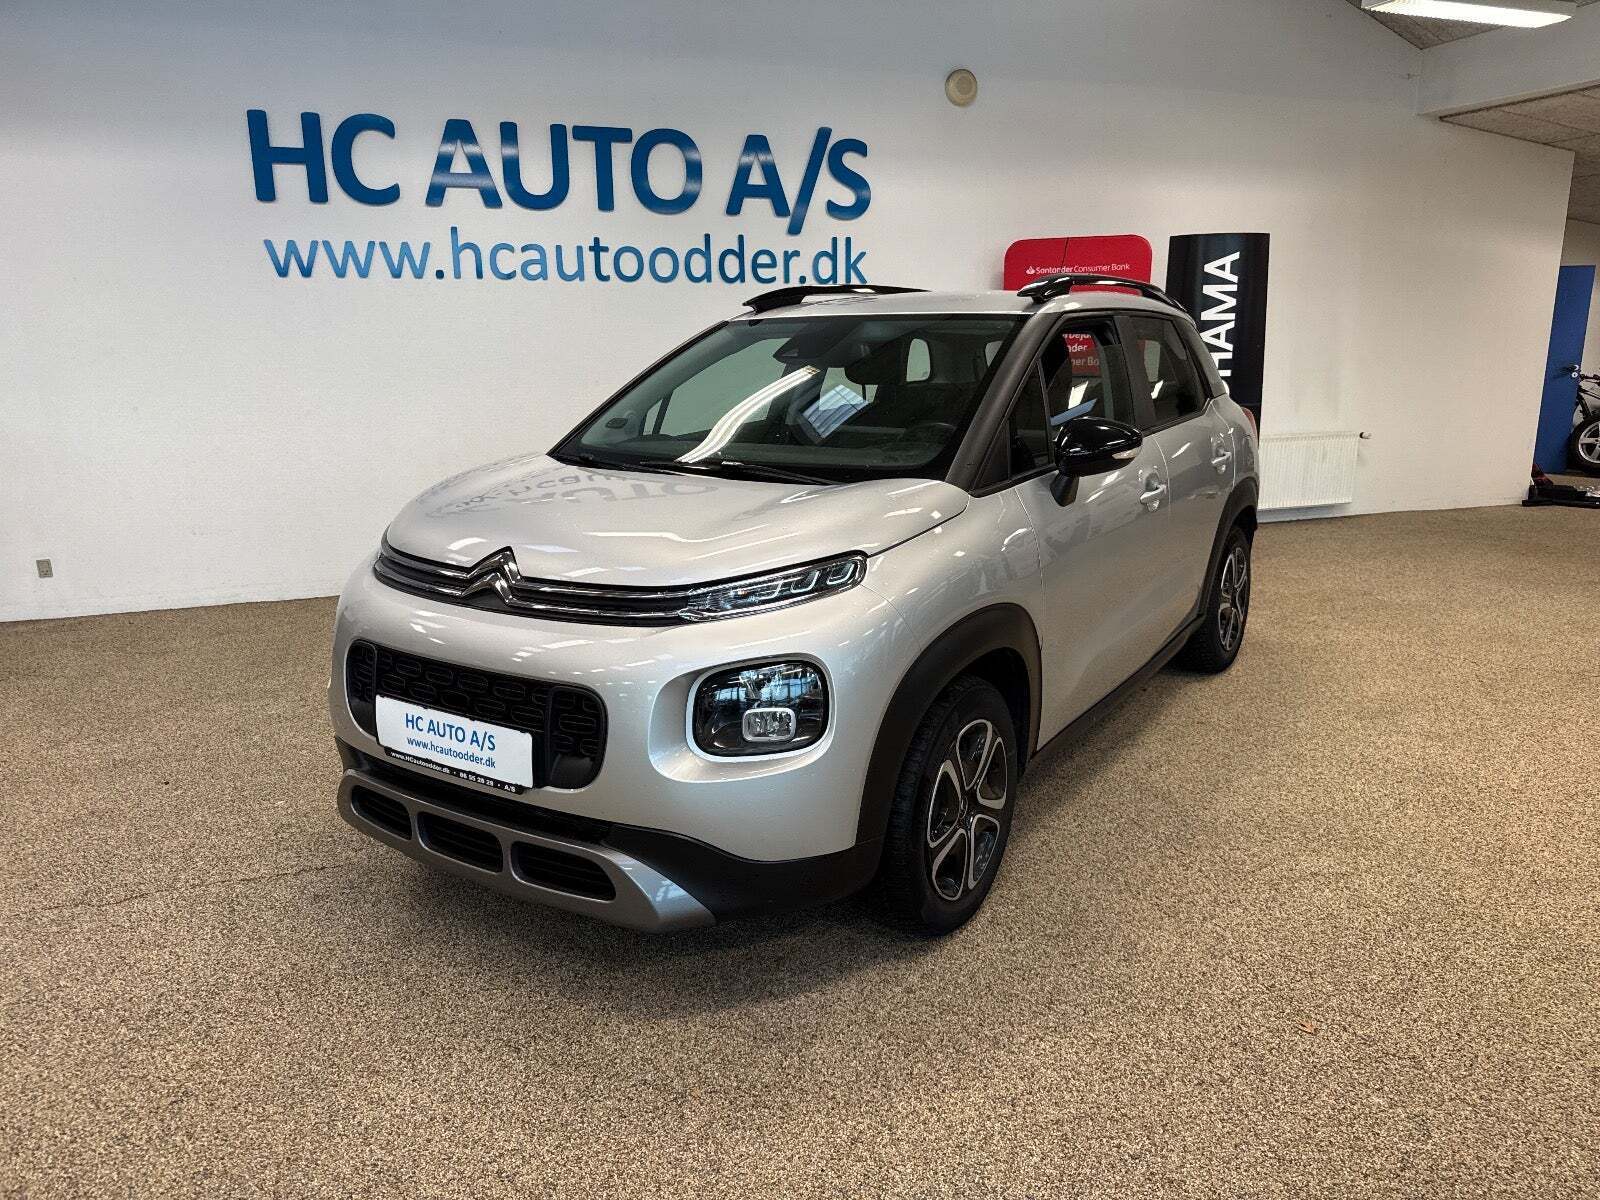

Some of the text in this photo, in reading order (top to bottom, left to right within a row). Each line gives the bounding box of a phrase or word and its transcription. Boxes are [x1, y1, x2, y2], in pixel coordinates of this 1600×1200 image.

[246, 109, 872, 236] HC AUTO A/S
[264, 226, 868, 285] www.hcautoodder.dk
[1036, 263, 1130, 275] Santander Consumer Bank
[1200, 251, 1241, 395] HAMA
[405, 712, 496, 752] HC AUTO A/S
[406, 735, 496, 769] www.hcautoodder.dk
